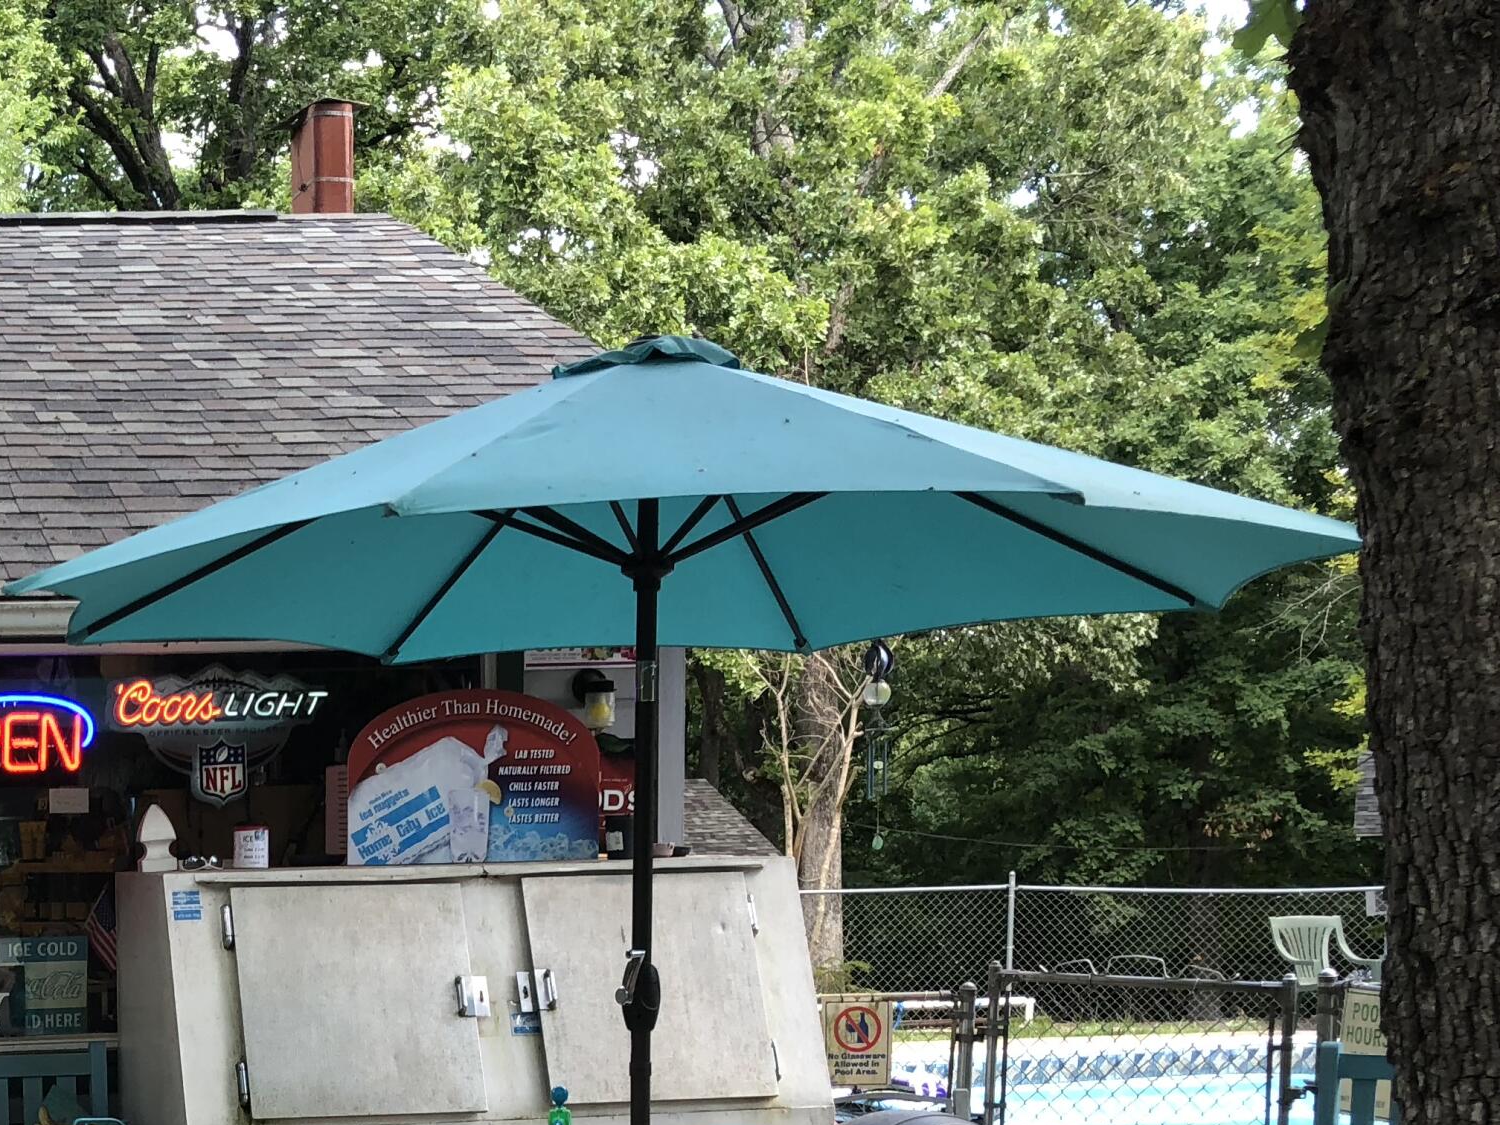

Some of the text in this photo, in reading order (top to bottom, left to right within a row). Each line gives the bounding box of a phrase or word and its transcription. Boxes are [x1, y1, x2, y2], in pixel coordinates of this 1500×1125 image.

[116, 680, 329, 725] Coors LIGHT
[367, 698, 578, 749] Healthier Than Homemade!
[515, 749, 555, 760] LAB TESTED
[498, 764, 571, 775] NATURALLY FILTERED
[203, 766, 242, 794] NFL
[509, 781, 560, 791] CHILLS FASTER
[509, 797, 560, 807] LASTS LONGER
[534, 813, 560, 823] BETTER
[358, 803, 446, 860] Home City Ice
[8, 941, 78, 957] ICE COLD
[1352, 1002, 1379, 1023] POO
[25, 1013, 82, 1028] LD HERE
[834, 1060, 869, 1068] Allowed
